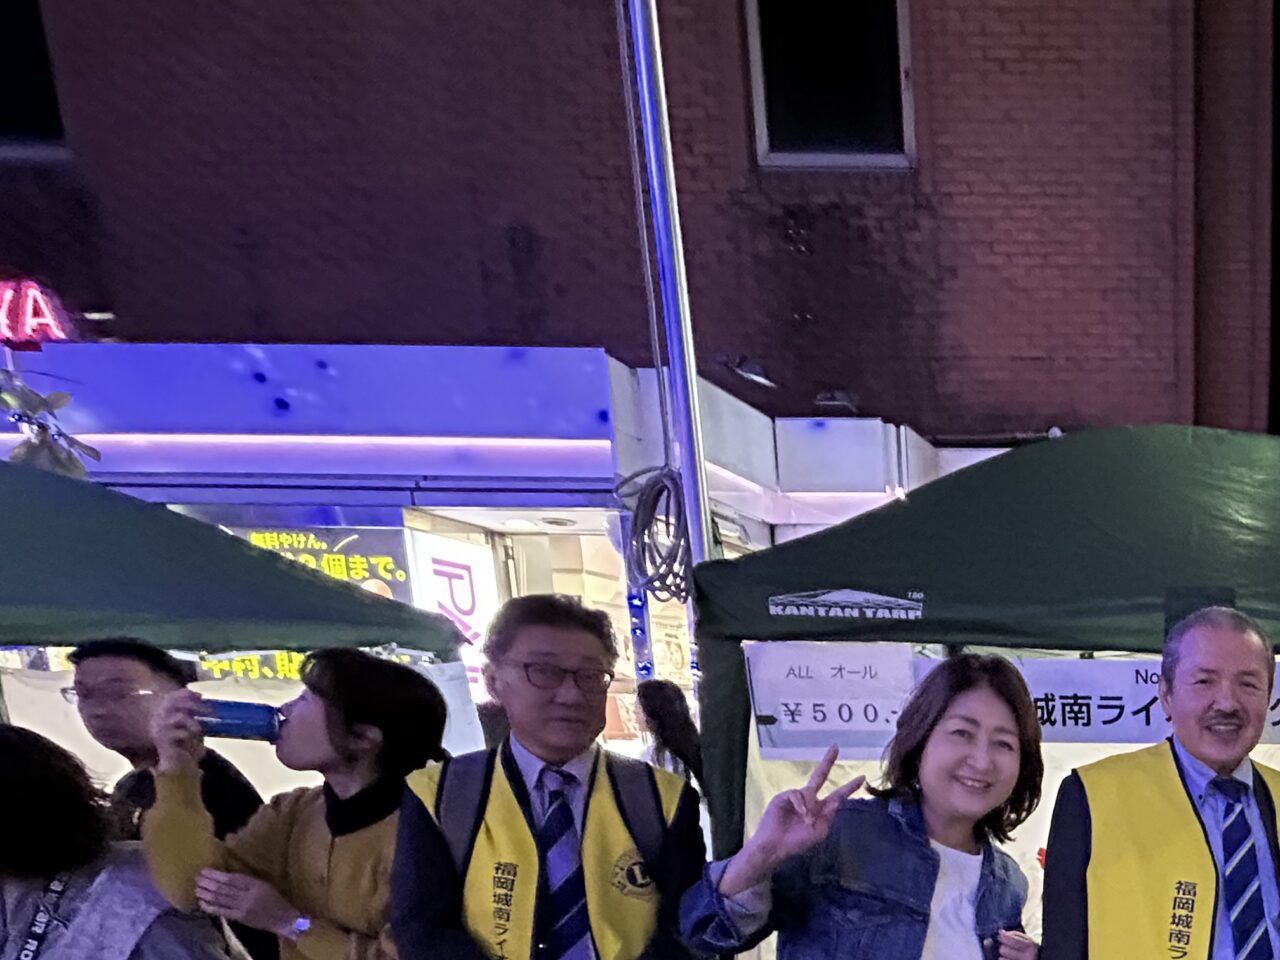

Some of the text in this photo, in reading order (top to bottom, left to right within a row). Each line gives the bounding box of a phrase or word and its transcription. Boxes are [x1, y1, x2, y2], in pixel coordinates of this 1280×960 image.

[769, 604, 922, 620] KANTAN TARP
[785, 665, 878, 680] ALL オール
